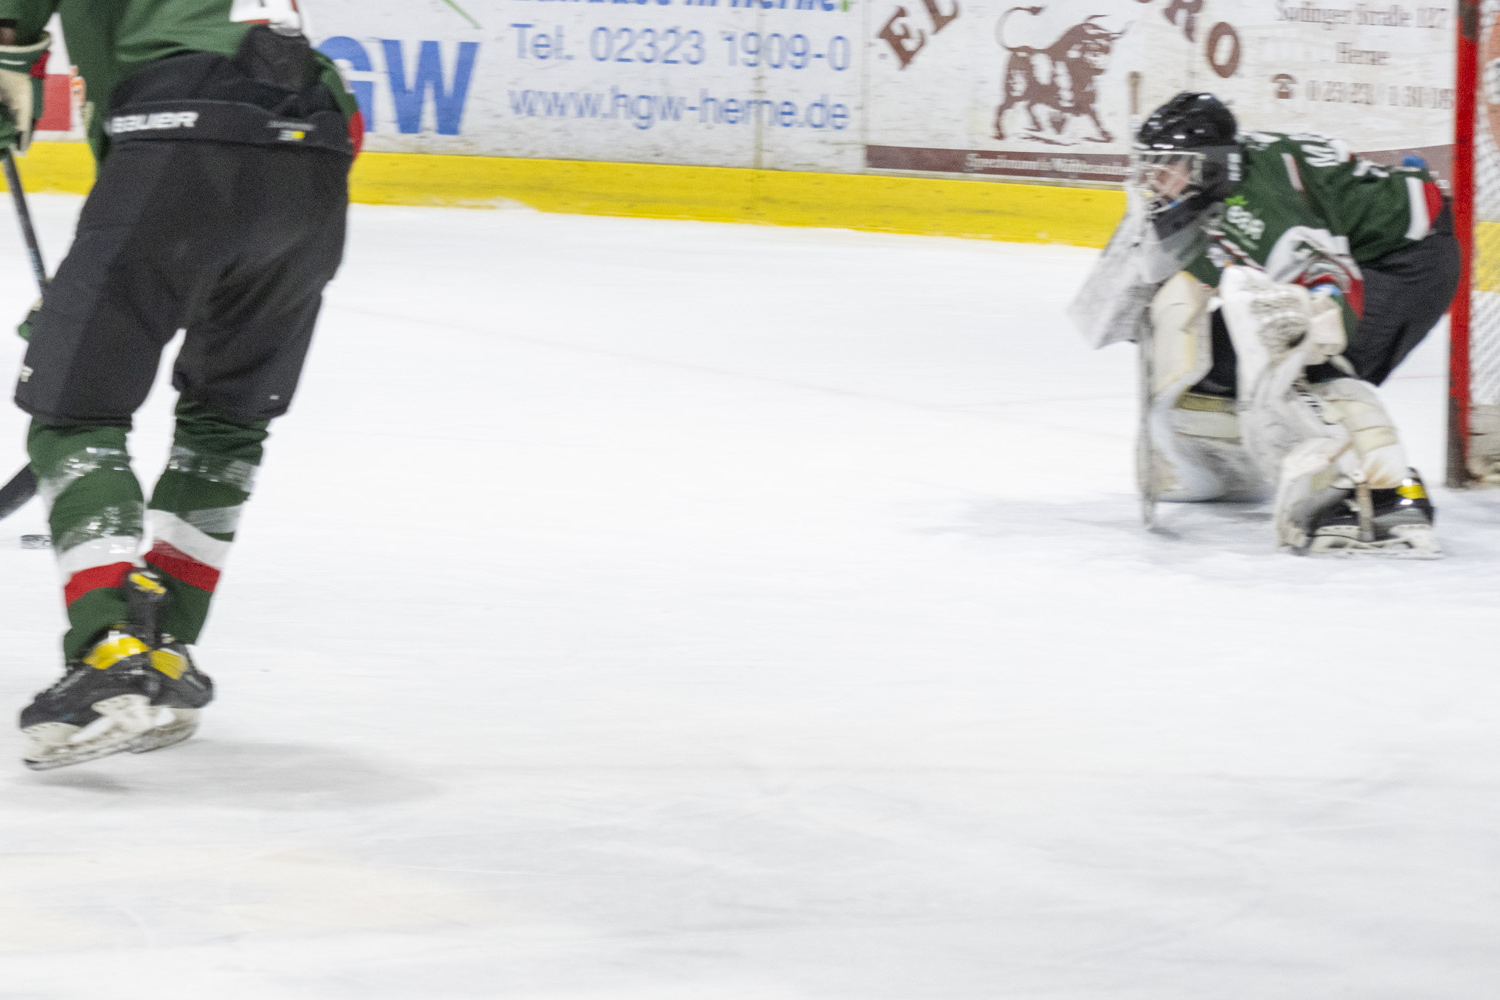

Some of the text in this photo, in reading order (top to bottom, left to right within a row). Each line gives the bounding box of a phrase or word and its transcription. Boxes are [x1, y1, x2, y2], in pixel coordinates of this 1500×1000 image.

[508, 22, 852, 71] Tel. 02323 1909-0
[317, 36, 483, 135] GW
[507, 85, 852, 131] www.hgw-herne.de
